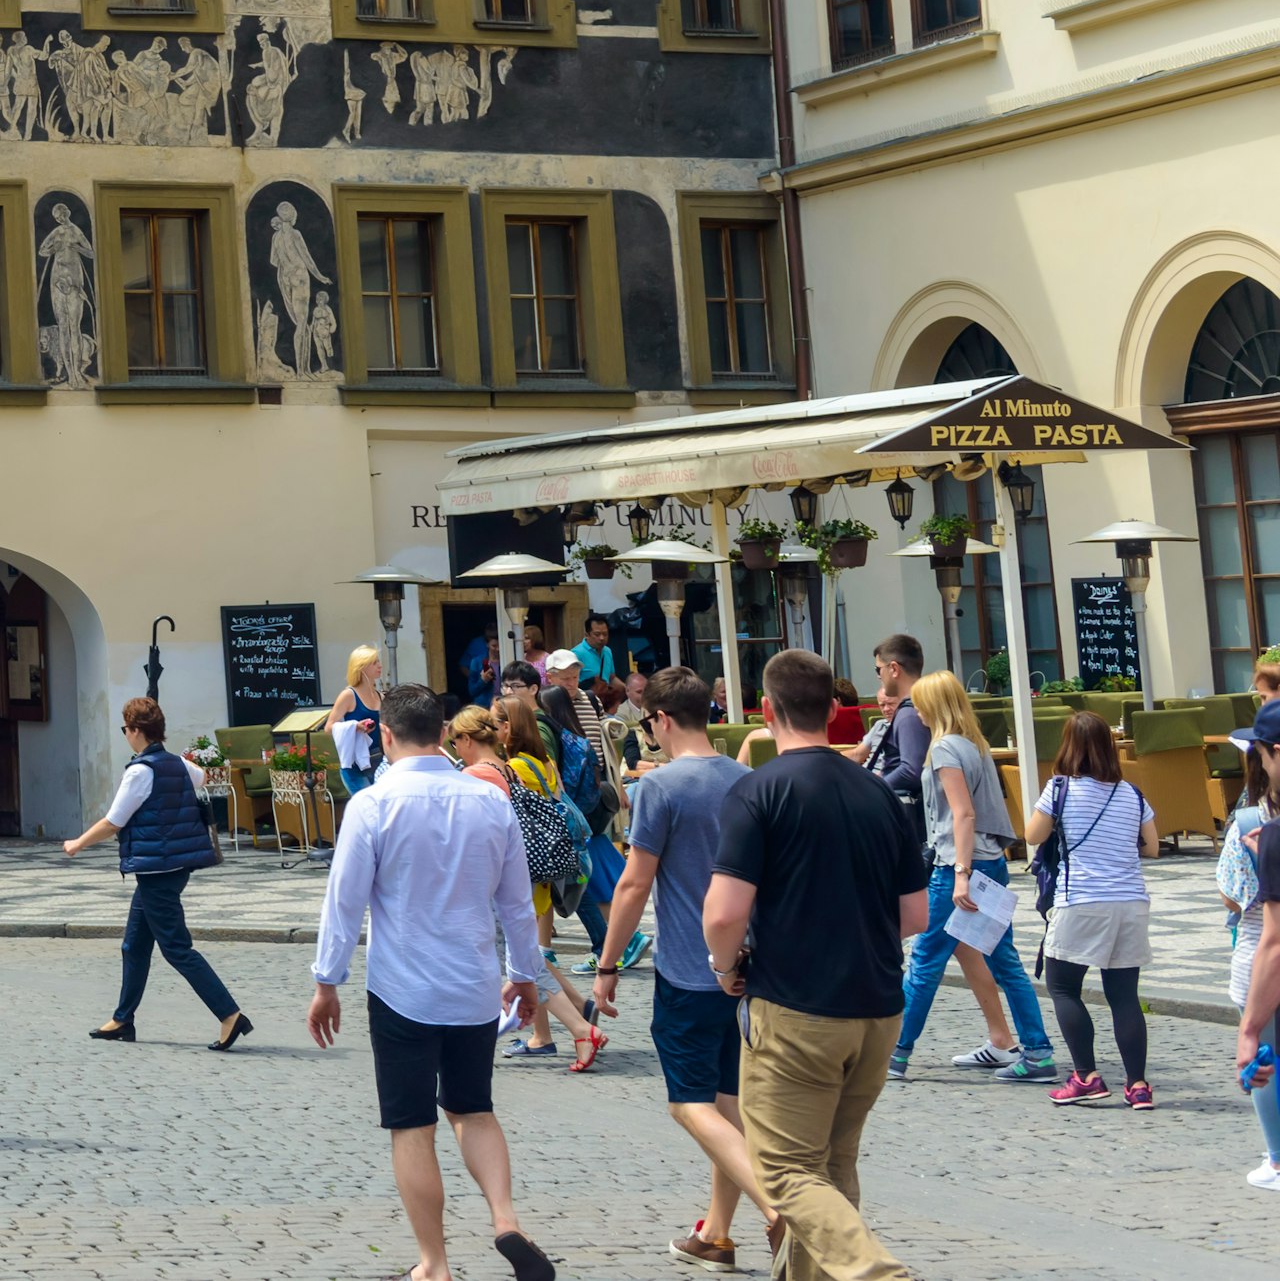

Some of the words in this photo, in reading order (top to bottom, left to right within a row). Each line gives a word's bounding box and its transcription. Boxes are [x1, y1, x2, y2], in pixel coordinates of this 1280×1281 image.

[979, 399, 1001, 417] Al
[1005, 399, 1072, 417] Minuto
[930, 425, 1013, 447] PIZZA
[1033, 424, 1124, 446] PASTA
[618, 471, 663, 487] SPAGHETTI
[665, 468, 696, 484] HOUSE
[450, 495, 470, 506] PIZZA
[471, 491, 493, 504] PASTA
